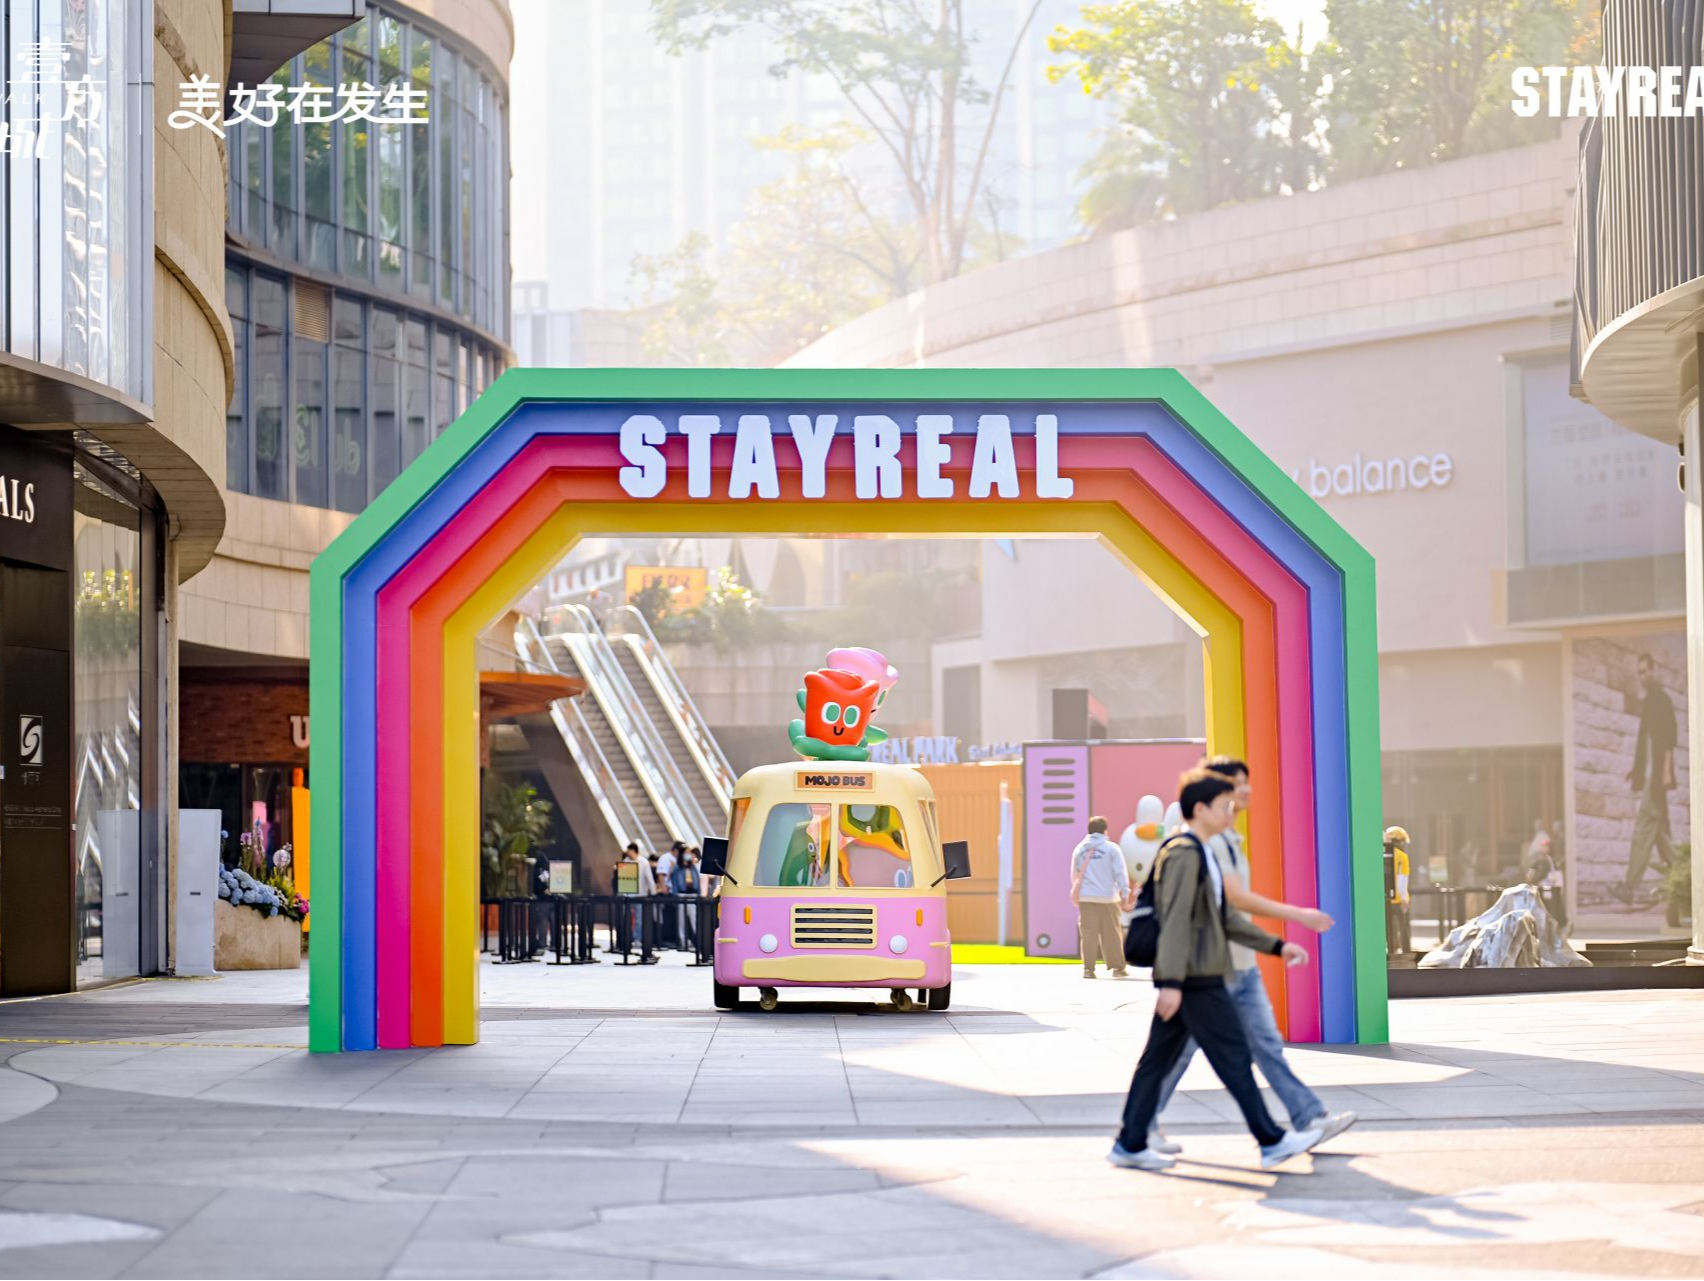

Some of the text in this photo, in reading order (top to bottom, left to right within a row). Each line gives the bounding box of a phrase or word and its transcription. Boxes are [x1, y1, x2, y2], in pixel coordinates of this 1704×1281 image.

[619, 414, 1074, 499] STAYREAL
[1310, 453, 1452, 498] balance
[914, 736, 959, 764] PARK
[805, 775, 865, 786] MOJO BUS
